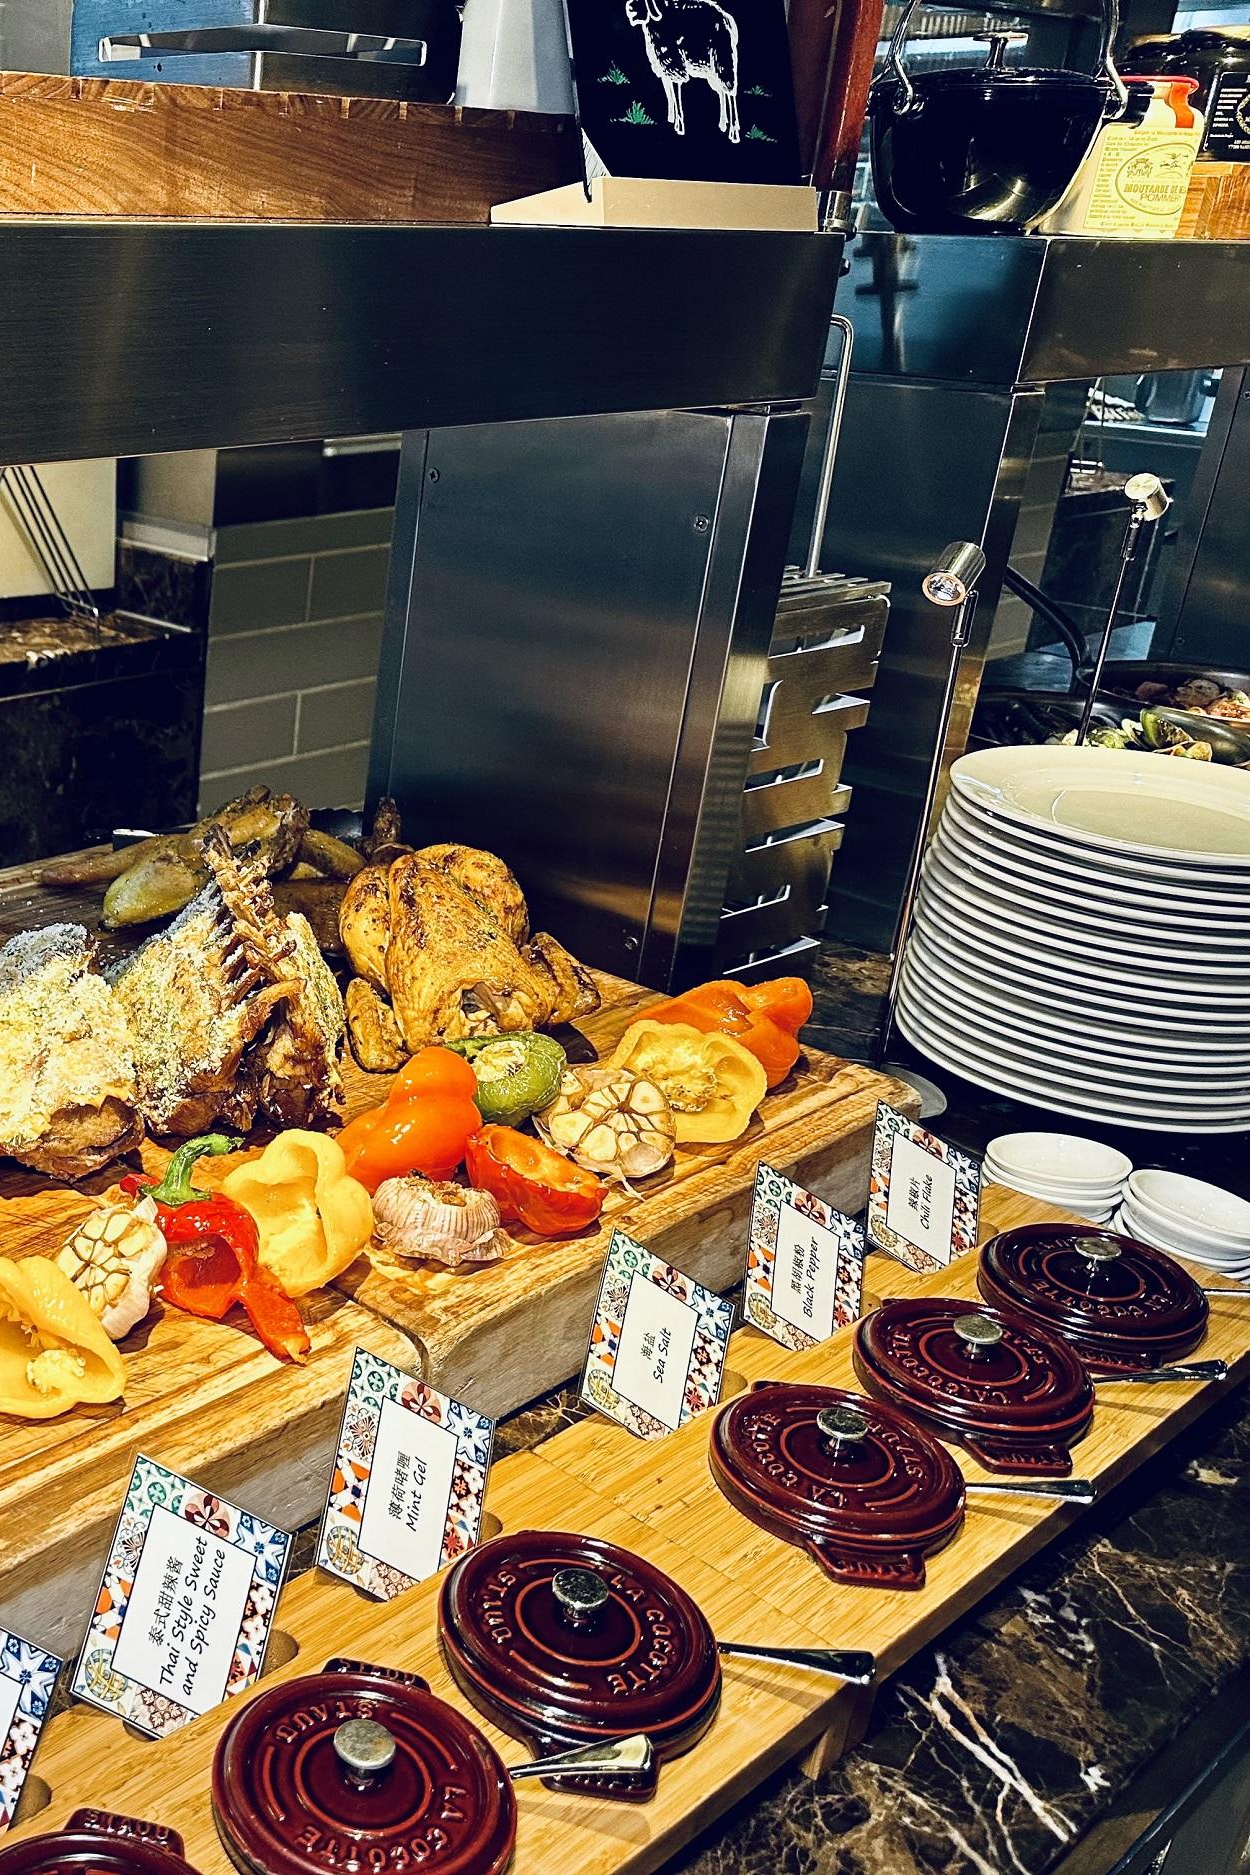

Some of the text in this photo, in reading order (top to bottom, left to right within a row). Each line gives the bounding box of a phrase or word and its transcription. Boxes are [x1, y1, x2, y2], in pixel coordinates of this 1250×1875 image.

[921, 1174, 934, 1204] Flake
[802, 1236, 820, 1319] Black Pepper
[652, 1327, 672, 1384] Sea Salt
[405, 1456, 428, 1532] Mint Gel
[158, 1536, 209, 1687] Thai Style Sweet
[181, 1548, 227, 1697] and Spicy Sauce
[610, 1574, 645, 1602] LA
